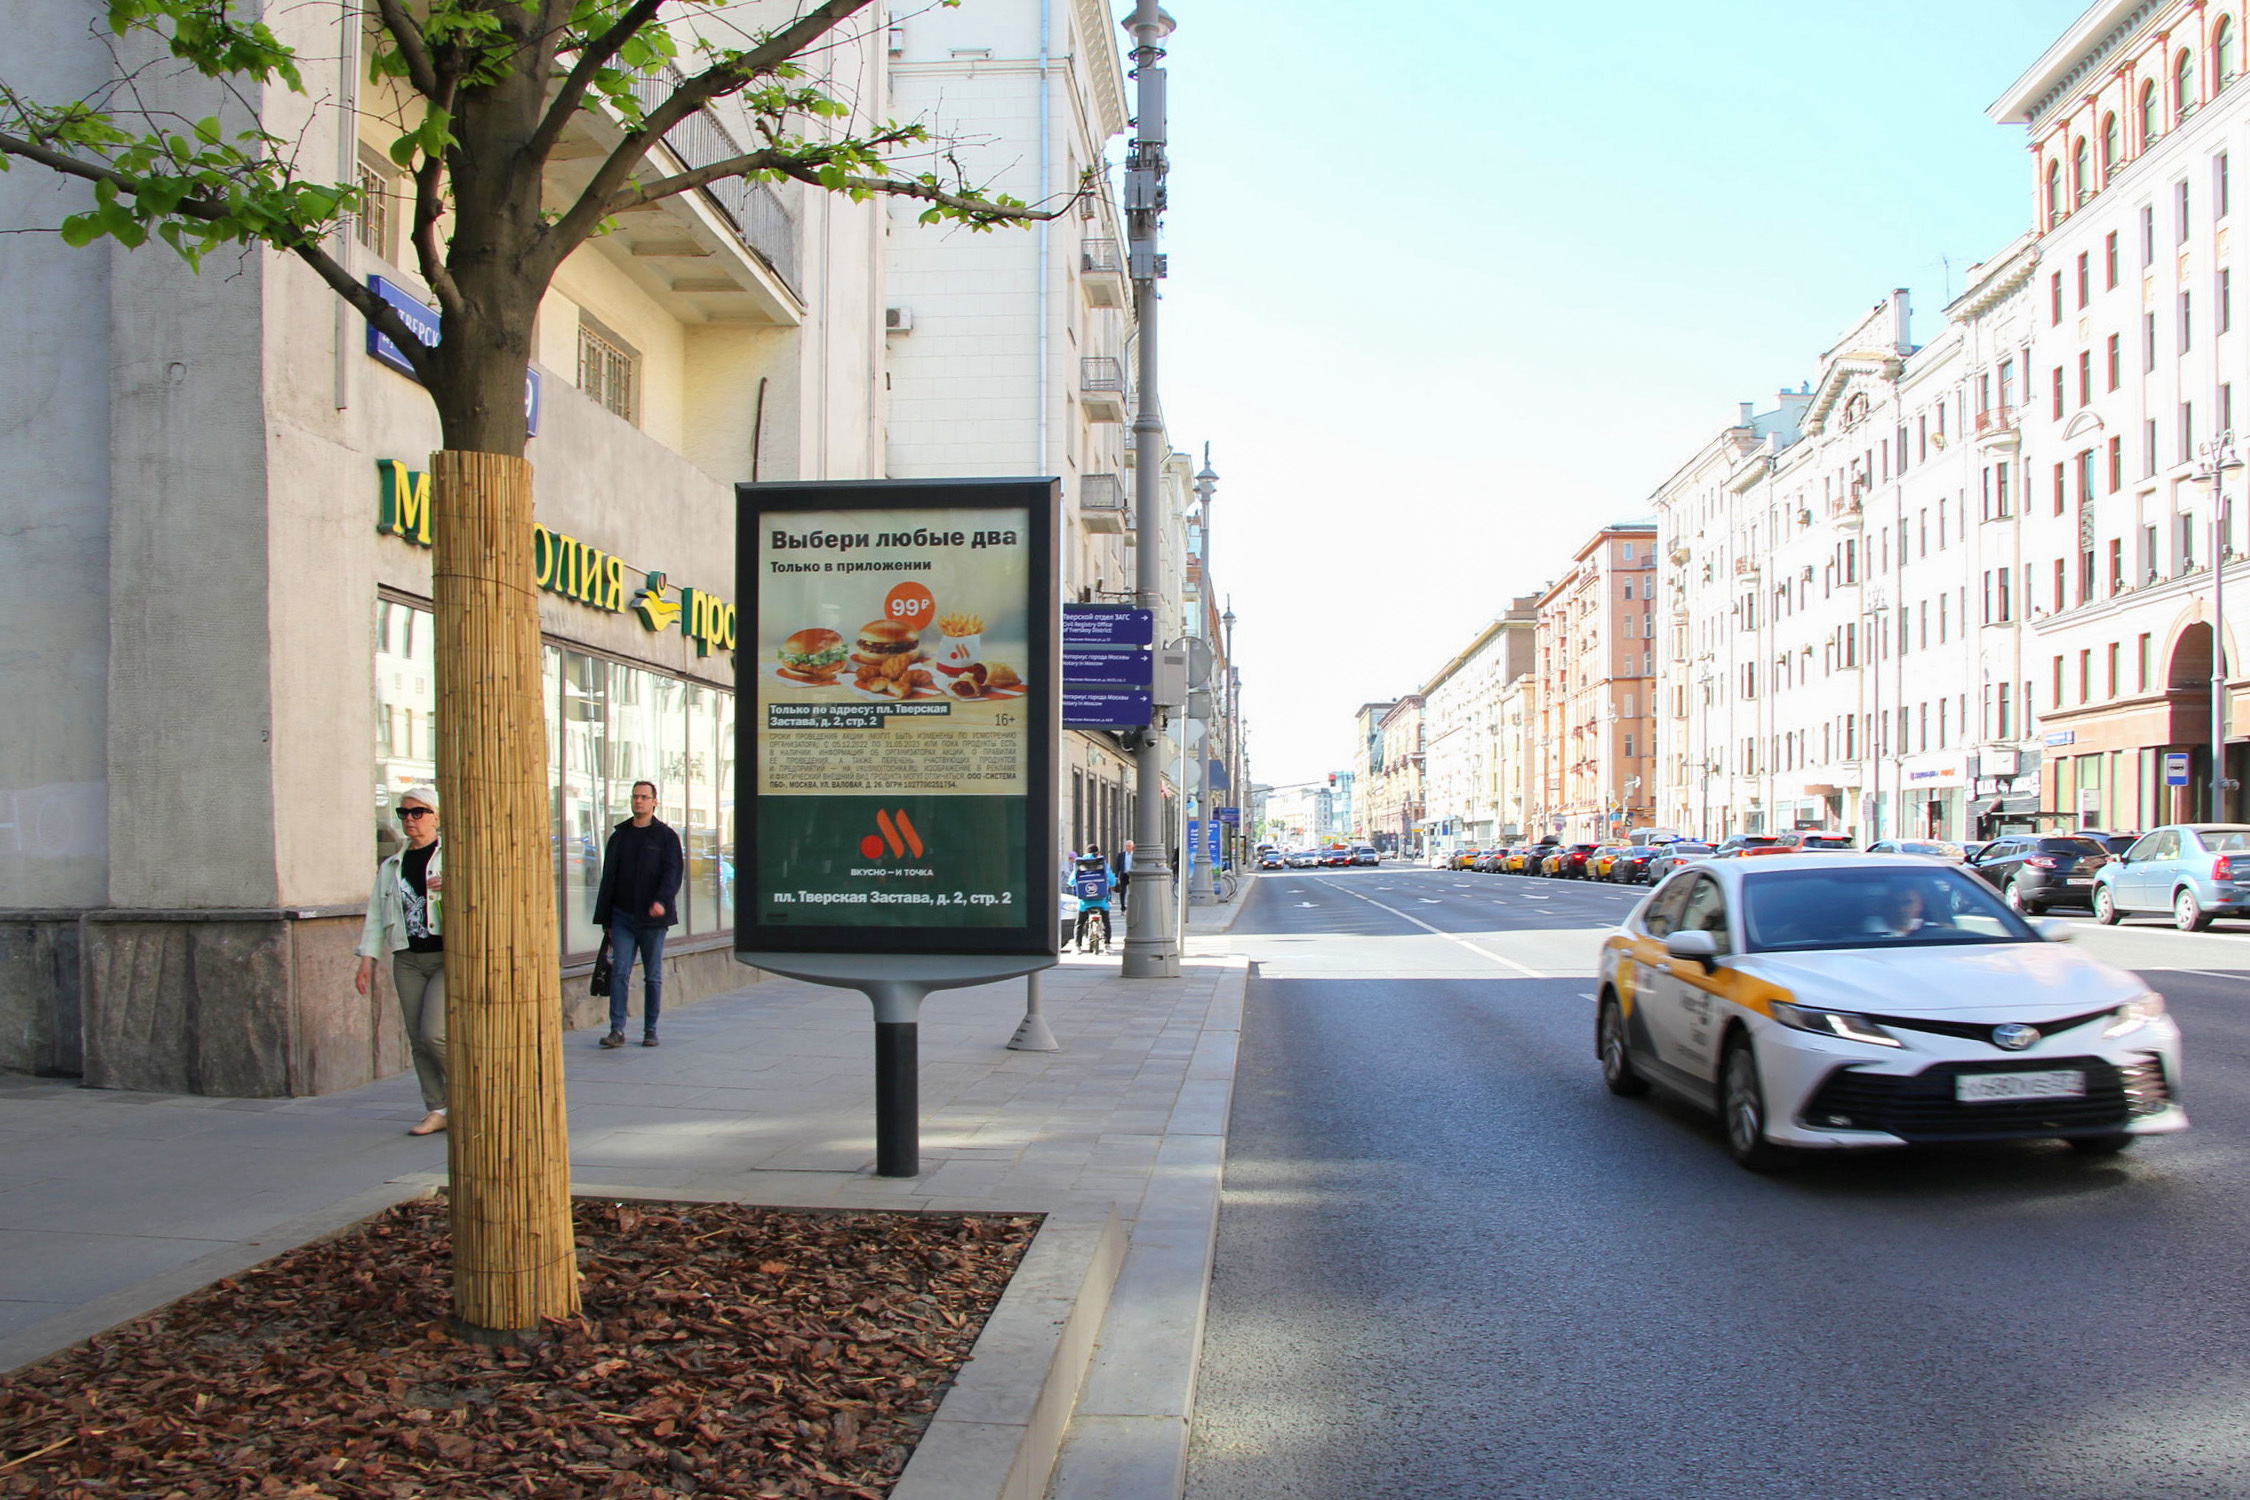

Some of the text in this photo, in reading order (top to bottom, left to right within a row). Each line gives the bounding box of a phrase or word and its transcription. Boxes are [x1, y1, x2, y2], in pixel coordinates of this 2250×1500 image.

[771, 528, 1017, 552] Выбери любые два
[392, 459, 736, 657] МОЛИЯ про
[771, 560, 931, 574] Только в приложении
[1114, 613, 1130, 621] ЗАГС
[770, 704, 948, 716] Только по адресу: пл. Тверская
[770, 717, 877, 727] Застава, д. 2, стр. 2
[995, 713, 1015, 726] 16+
[850, 868, 886, 876] ВКУСНО
[895, 868, 902, 876] И
[904, 868, 934, 876] ТОЧКА
[774, 891, 1012, 906] пл. Тверская Застава, д. 2, стр. 2
